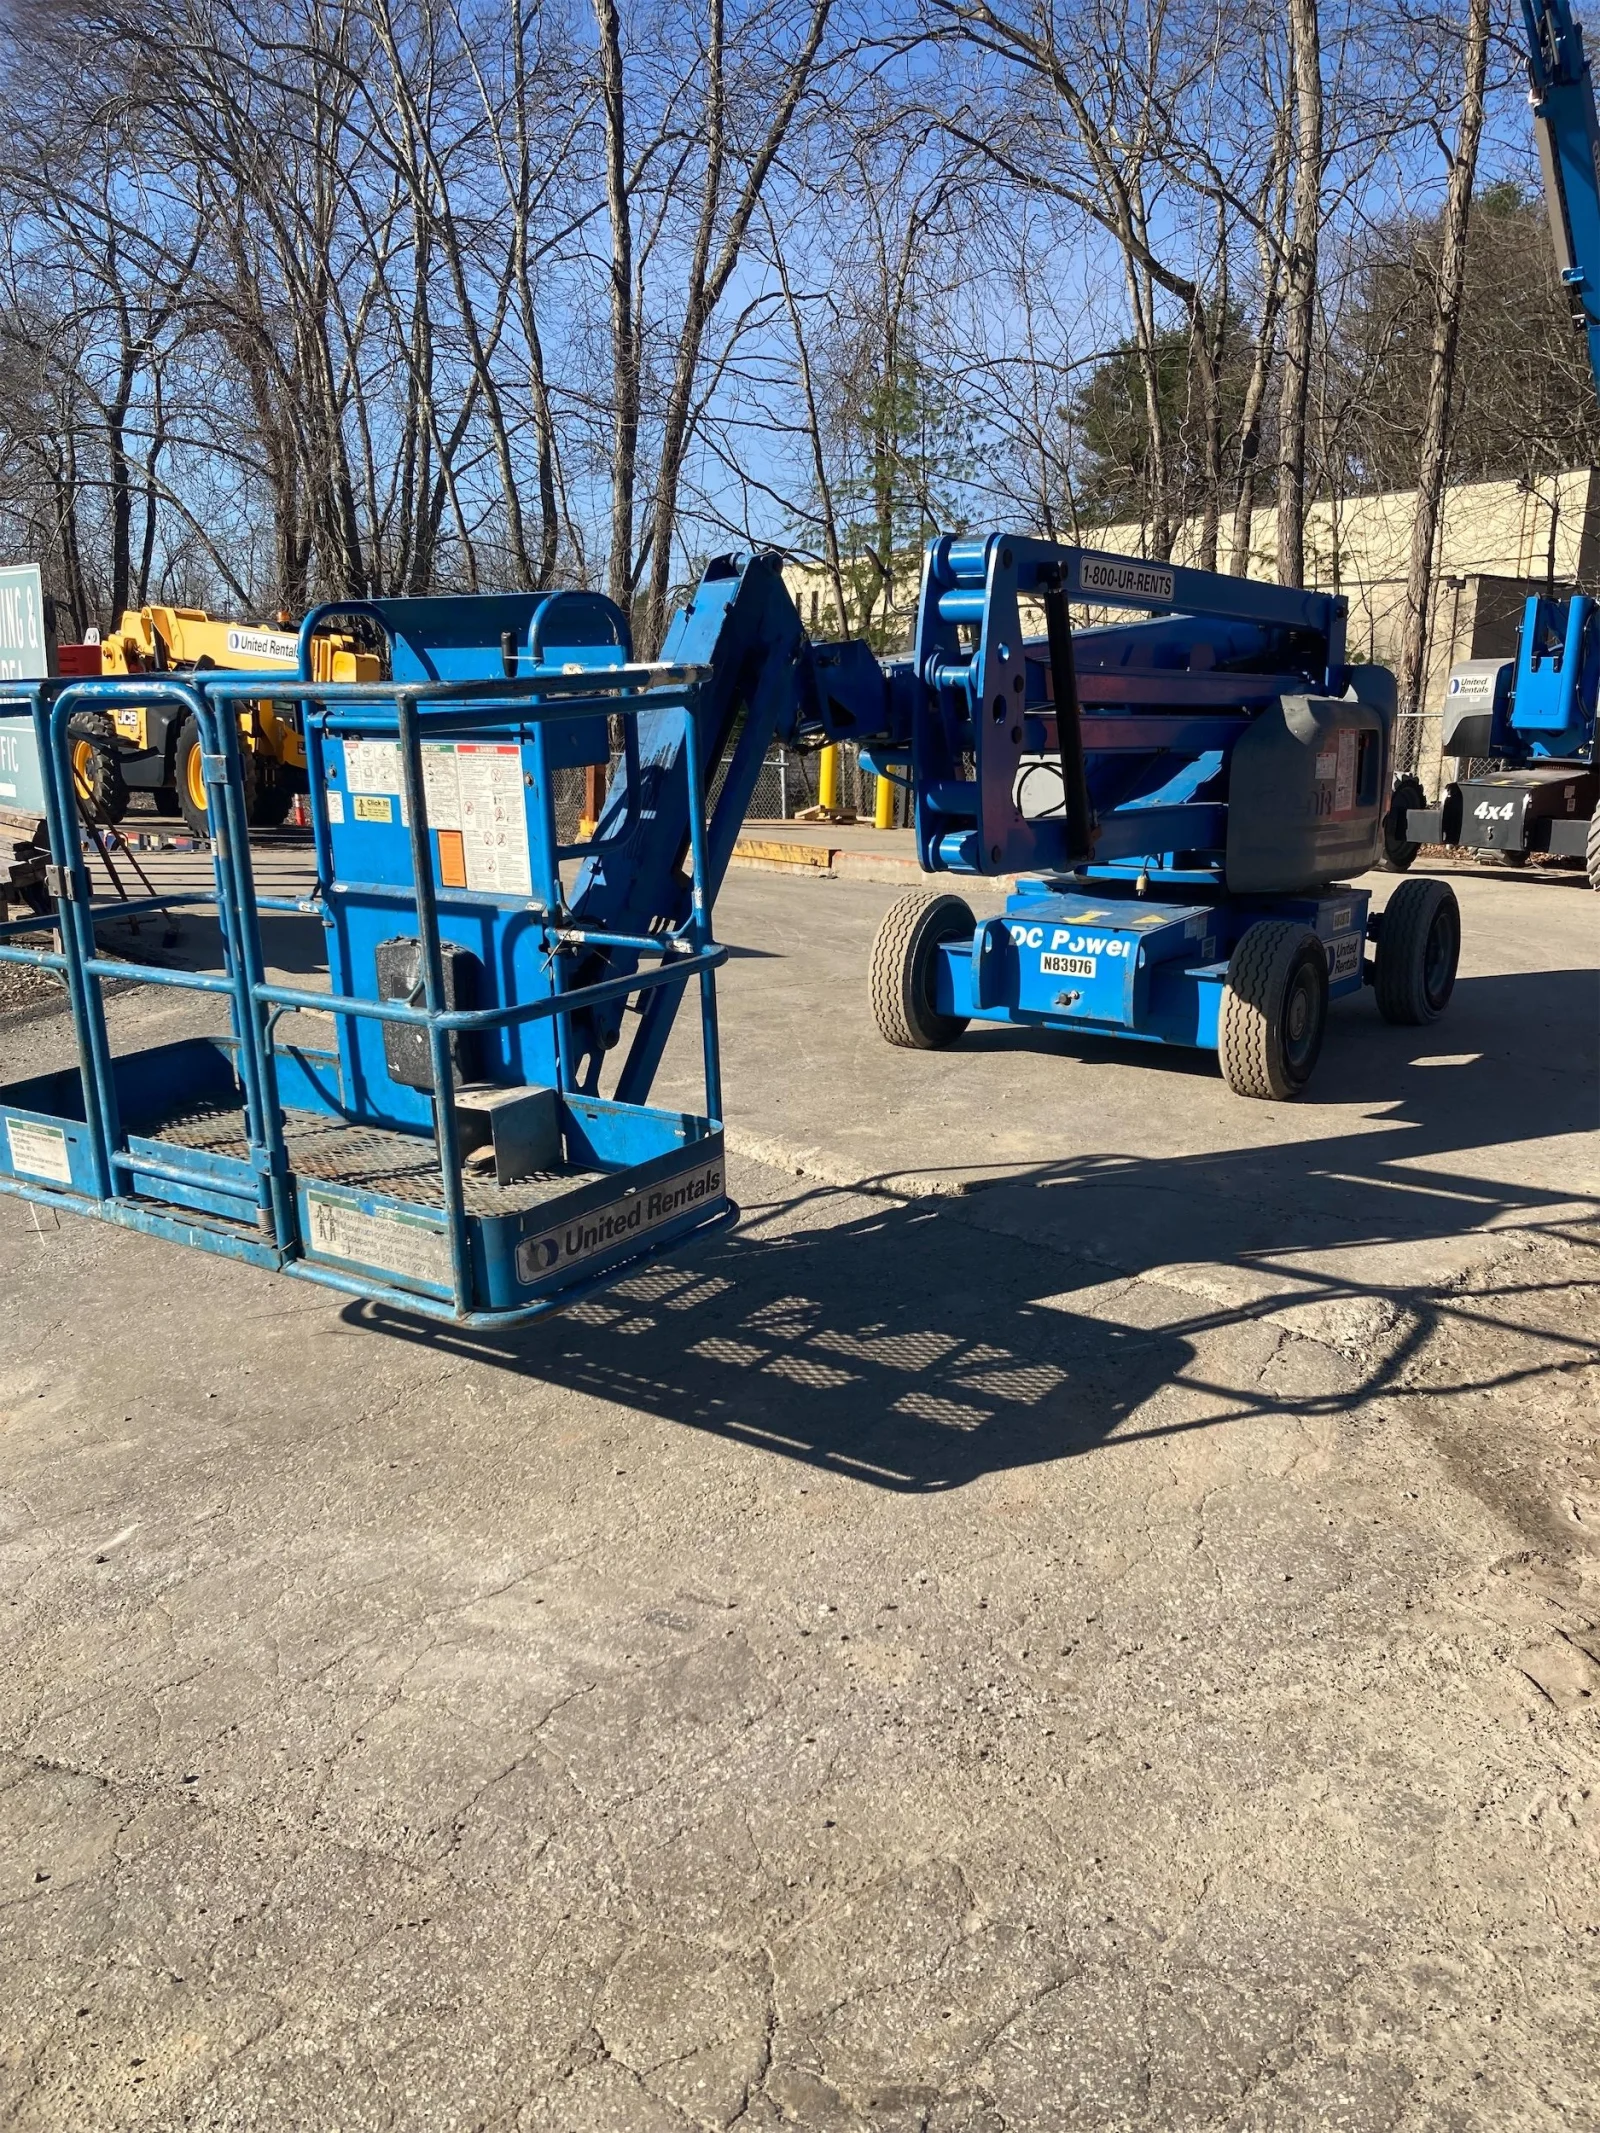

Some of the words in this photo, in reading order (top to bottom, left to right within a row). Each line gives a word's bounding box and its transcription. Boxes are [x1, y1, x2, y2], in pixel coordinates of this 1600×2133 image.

[1083, 564, 1172, 595] 1-800-UR-RENTS
[0, 587, 24, 649] ING
[26, 585, 39, 649] &
[241, 636, 268, 652] United
[1459, 686, 1489, 694] Rentals
[1461, 678, 1489, 686] United
[118, 710, 137, 725] JCB
[0, 736, 19, 773] FIC
[1473, 801, 1515, 820] 4x4
[1009, 925, 1044, 949] DC
[1050, 929, 1131, 958] Power
[1336, 938, 1358, 958] United
[1043, 956, 1093, 975] N83976
[1334, 957, 1358, 974] Rentals
[565, 1201, 642, 1256] United
[647, 1169, 721, 1220] Rentals
[414, 1240, 419, 1249] 2
